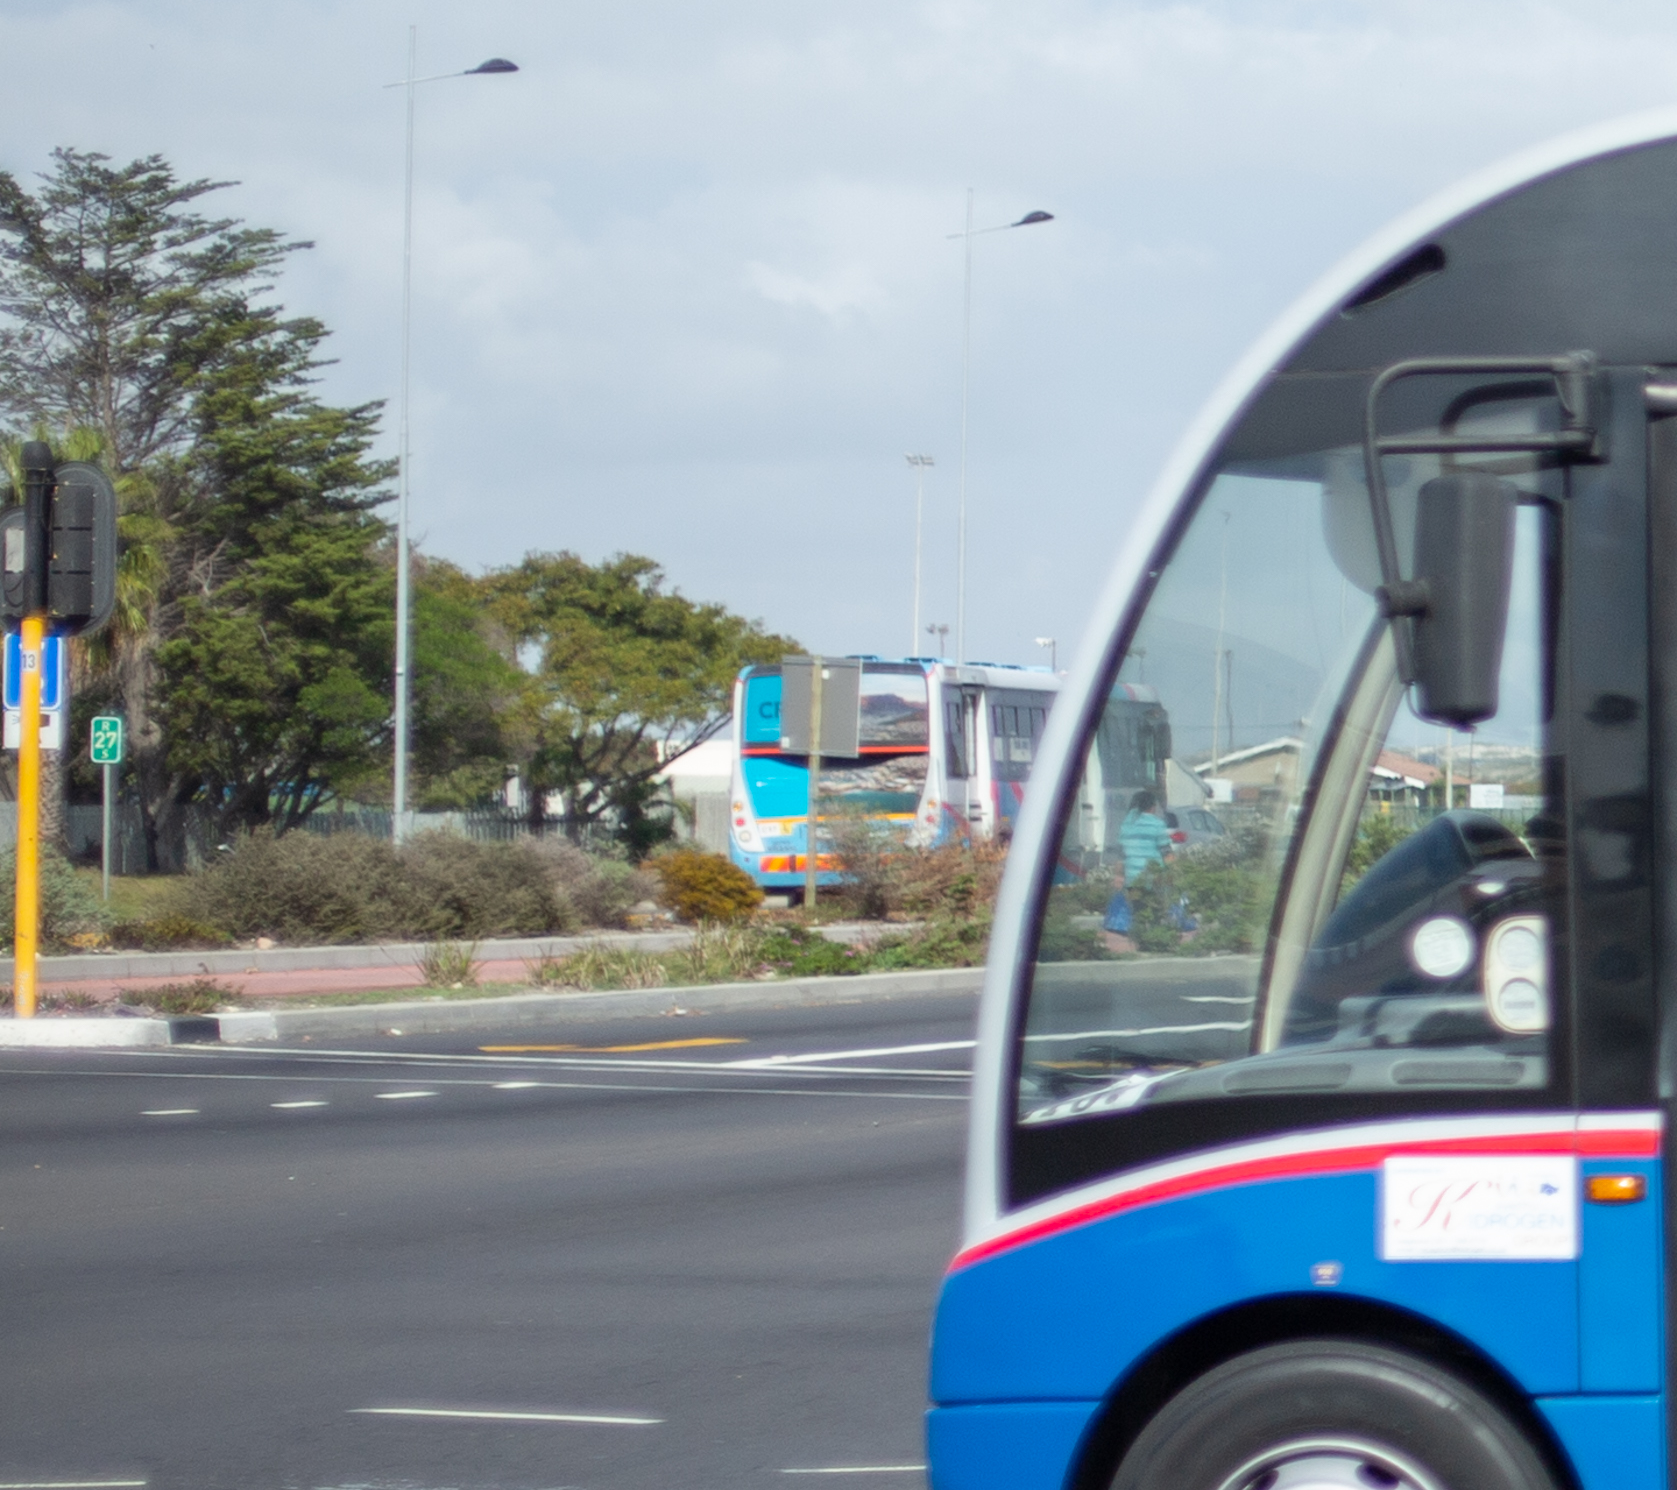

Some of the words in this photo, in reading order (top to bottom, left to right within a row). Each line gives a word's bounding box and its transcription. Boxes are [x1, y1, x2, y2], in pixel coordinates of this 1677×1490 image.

[22, 653, 36, 669] 13
[102, 721, 110, 731] R
[94, 732, 117, 749] 27
[101, 749, 109, 759] S
